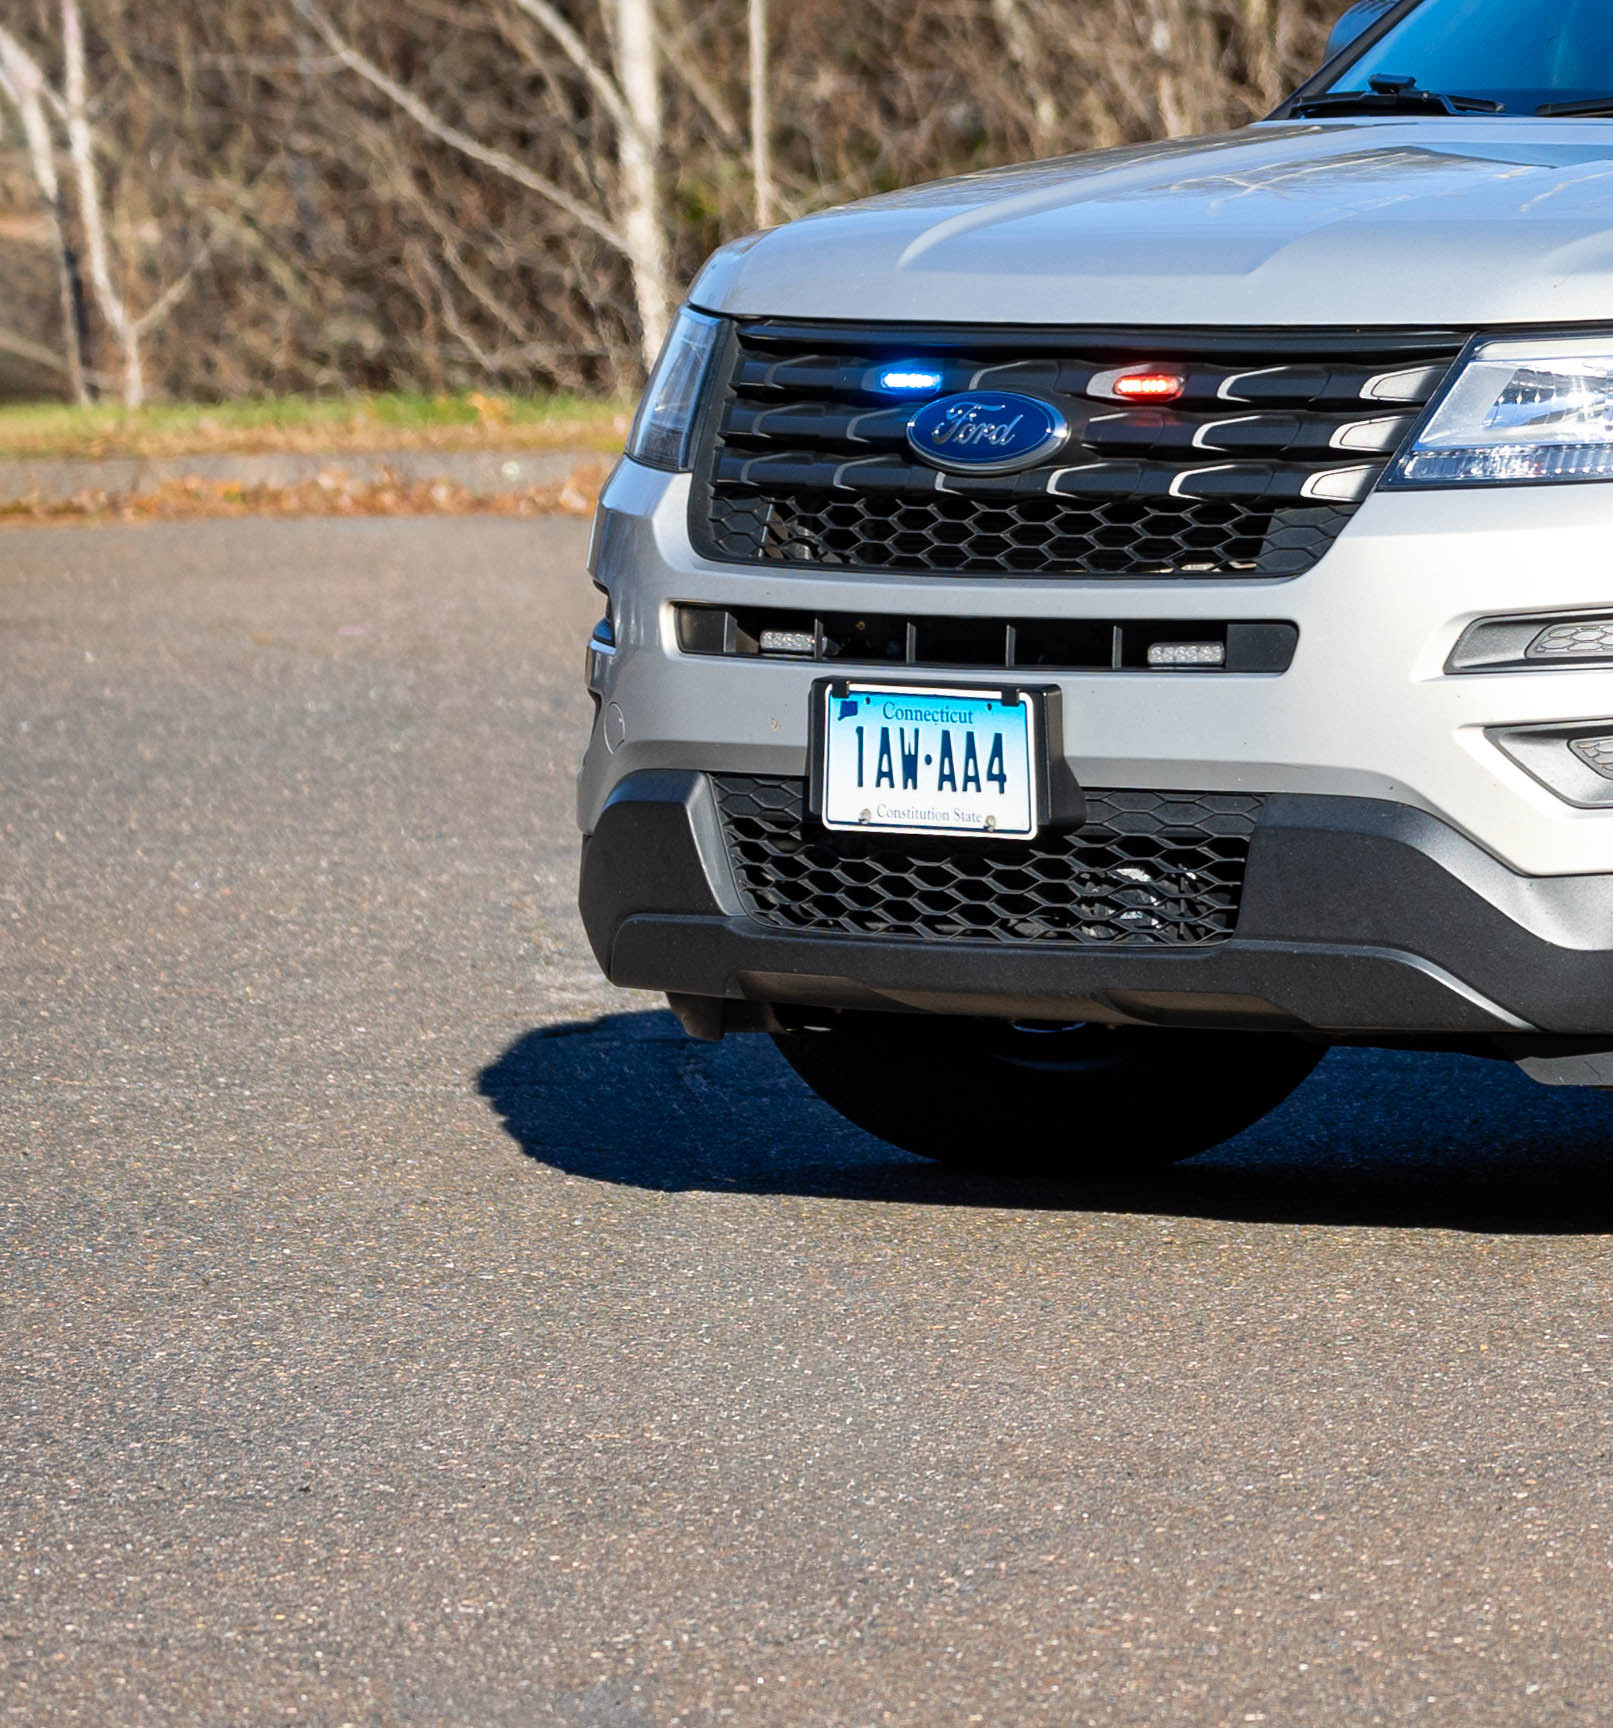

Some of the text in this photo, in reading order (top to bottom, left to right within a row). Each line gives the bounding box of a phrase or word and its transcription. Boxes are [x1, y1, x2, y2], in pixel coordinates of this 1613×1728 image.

[930, 401, 1023, 445] Ford
[883, 701, 974, 725] Connecticut
[876, 803, 983, 823] Constitution State
